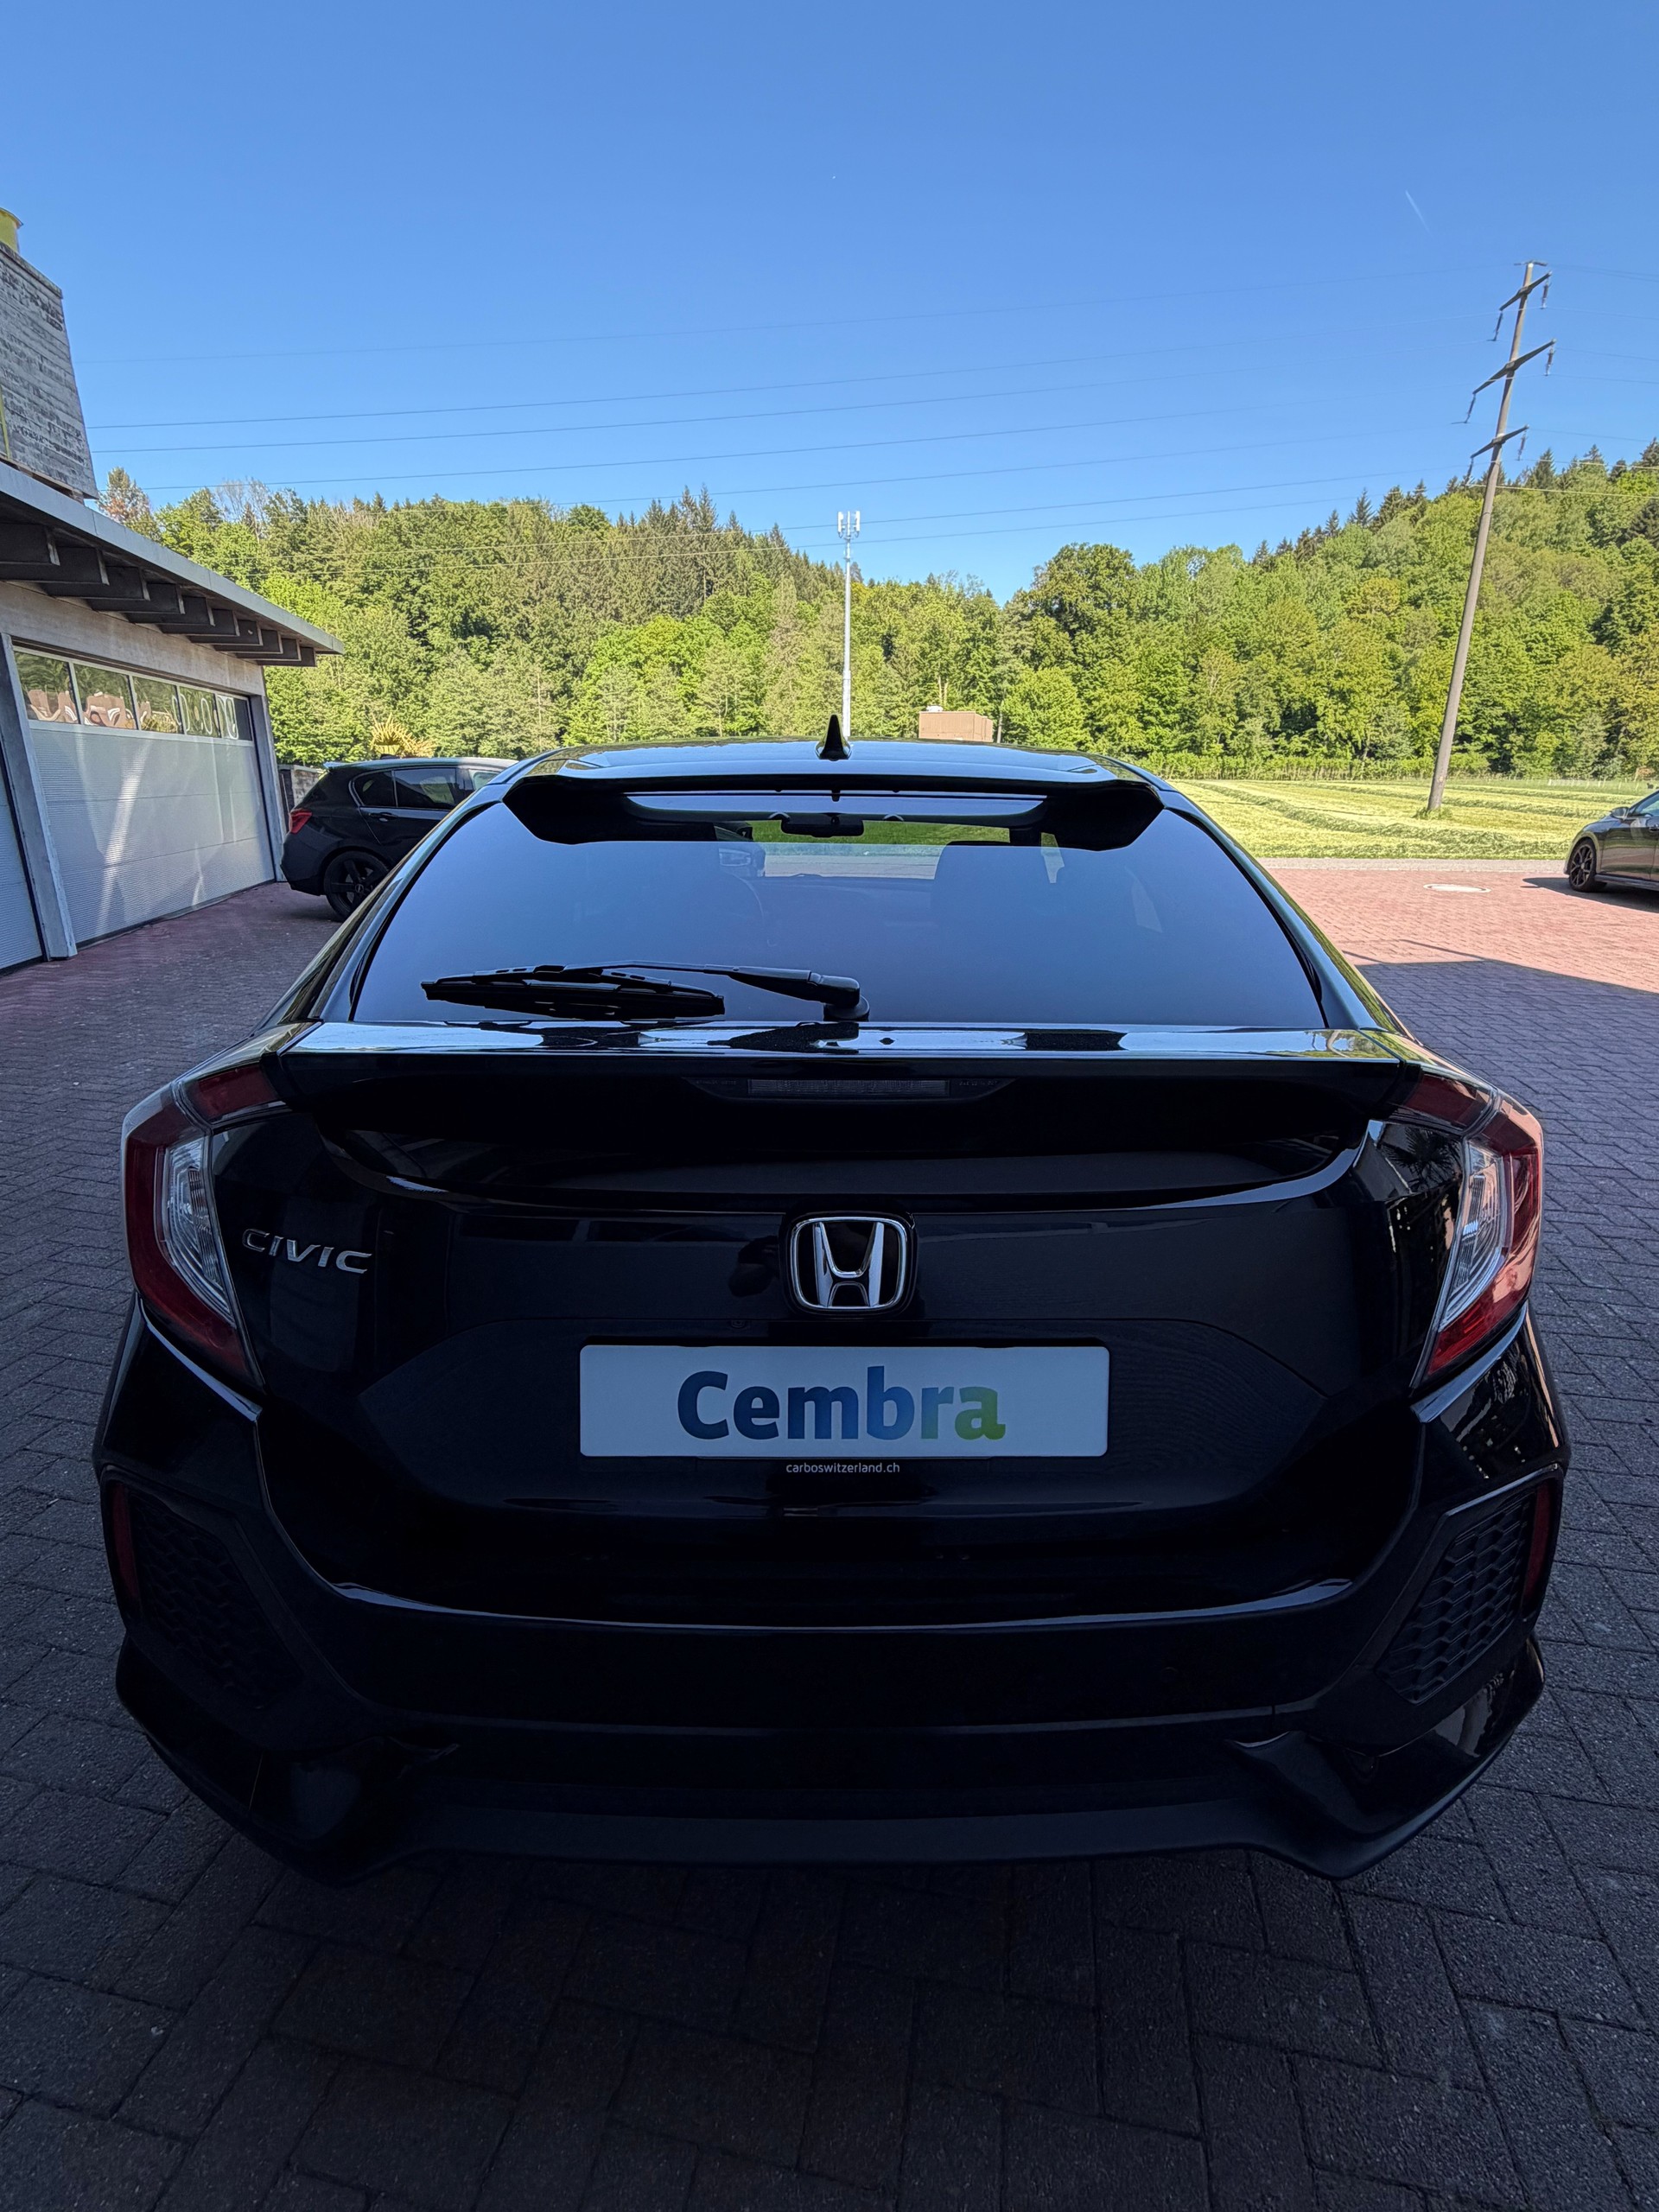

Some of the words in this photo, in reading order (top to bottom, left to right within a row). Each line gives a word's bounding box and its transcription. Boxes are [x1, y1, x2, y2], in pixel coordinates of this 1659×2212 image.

[242, 1228, 372, 1274] CIVIC
[677, 1365, 1007, 1440] Cembra
[785, 1462, 900, 1473] carboswitzerland.ch
